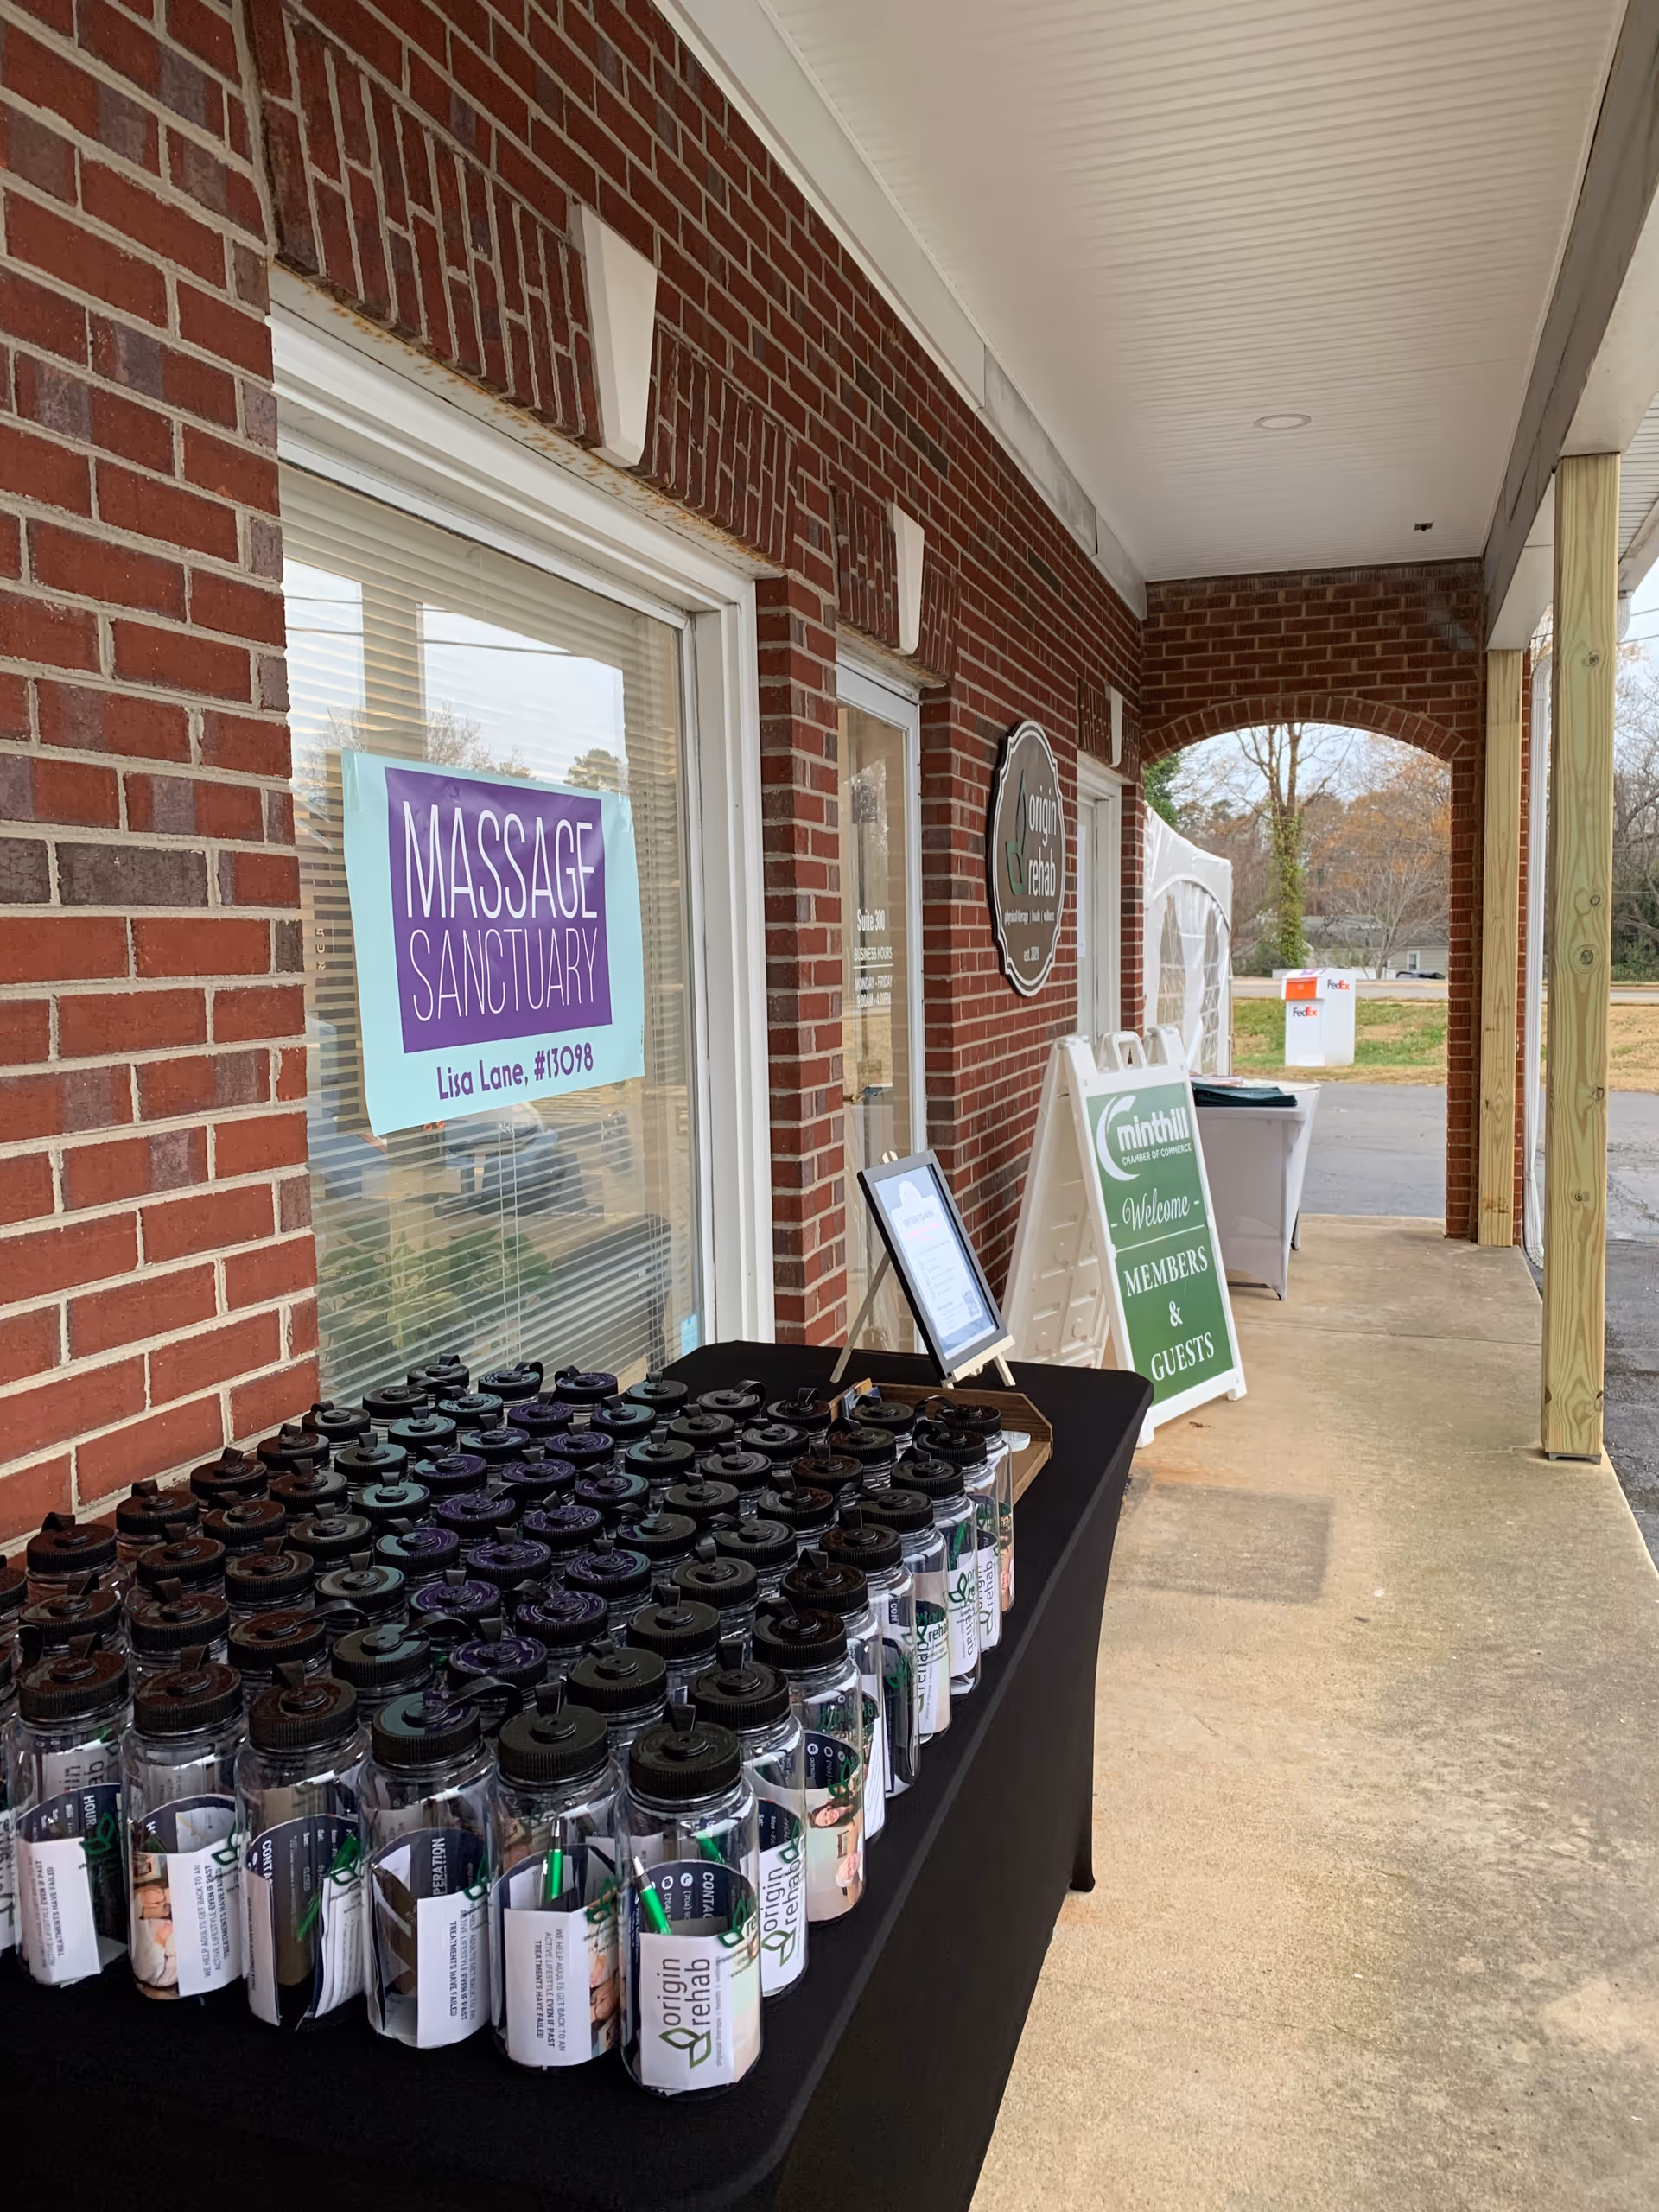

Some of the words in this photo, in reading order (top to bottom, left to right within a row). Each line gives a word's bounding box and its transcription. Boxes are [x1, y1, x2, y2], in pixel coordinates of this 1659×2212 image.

[1028, 785, 1057, 847] origin
[403, 800, 598, 919] MASSAGE
[1027, 847, 1056, 897] rehab
[856, 909, 874, 931] Suite
[874, 910, 885, 931] 300
[854, 947, 877, 961] BUSINESS
[878, 946, 893, 960] HOURS
[410, 926, 598, 1022] SANCTUARY
[855, 976, 874, 991] MONDAY
[878, 975, 893, 989] FRIDAY
[1326, 979, 1350, 990] FedEx
[1292, 1006, 1318, 1017] FedEx
[436, 1066, 474, 1100] Lisa
[479, 1059, 529, 1092] Lane,
[533, 1041, 594, 1081] #13098
[1116, 1106, 1190, 1152] minthill
[1122, 1151, 1151, 1166] CHAMBER
[1151, 1149, 1160, 1160] OF
[1160, 1142, 1192, 1158] COMMERCE
[1122, 1187, 1191, 1231] Welcome
[1123, 1245, 1209, 1297] MEMBERS
[1168, 1300, 1183, 1327] &
[1150, 1332, 1215, 1382] GUESTS
[983, 1560, 994, 1607] rehab
[84, 1795, 97, 1828] HOUR
[35, 1861, 43, 1878] PAST
[47, 1866, 56, 1891] FAILED
[193, 1865, 201, 1874] AN
[195, 1876, 202, 1885] TO
[204, 1865, 214, 1884] PAST
[196, 1885, 205, 1905] BACK
[206, 1884, 214, 1892] IF
[762, 1866, 785, 1932] origin
[785, 1859, 802, 1925] rehab
[207, 1892, 216, 1911] EVEN
[218, 1892, 226, 1912] HAVE
[663, 1892, 672, 1913] (704)
[683, 1891, 692, 1910] (704)
[197, 1908, 206, 1920] GET
[52, 1911, 64, 1956] TREATMENTS
[199, 1920, 208, 1947] ADULTS
[209, 1910, 219, 1945] LIFESTYLE
[219, 1911, 230, 1959] TREATMENTS
[555, 1929, 563, 1941] WE
[201, 1948, 210, 1966] HELP
[544, 1932, 553, 1958] ACTIVE
[555, 1941, 563, 1961] HELP
[213, 1946, 221, 1971] ACTIVE
[534, 1940, 543, 1991] TREATMENTS
[203, 1967, 211, 1978] WE
[545, 1960, 554, 1997] LIFESTYLE
[556, 1993, 565, 2006] GET
[656, 1957, 688, 2027] origin
[683, 1958, 711, 2027] rehab
[547, 2018, 555, 2027] IF
[558, 2029, 566, 2040] TO
[558, 2041, 567, 2051] AN
